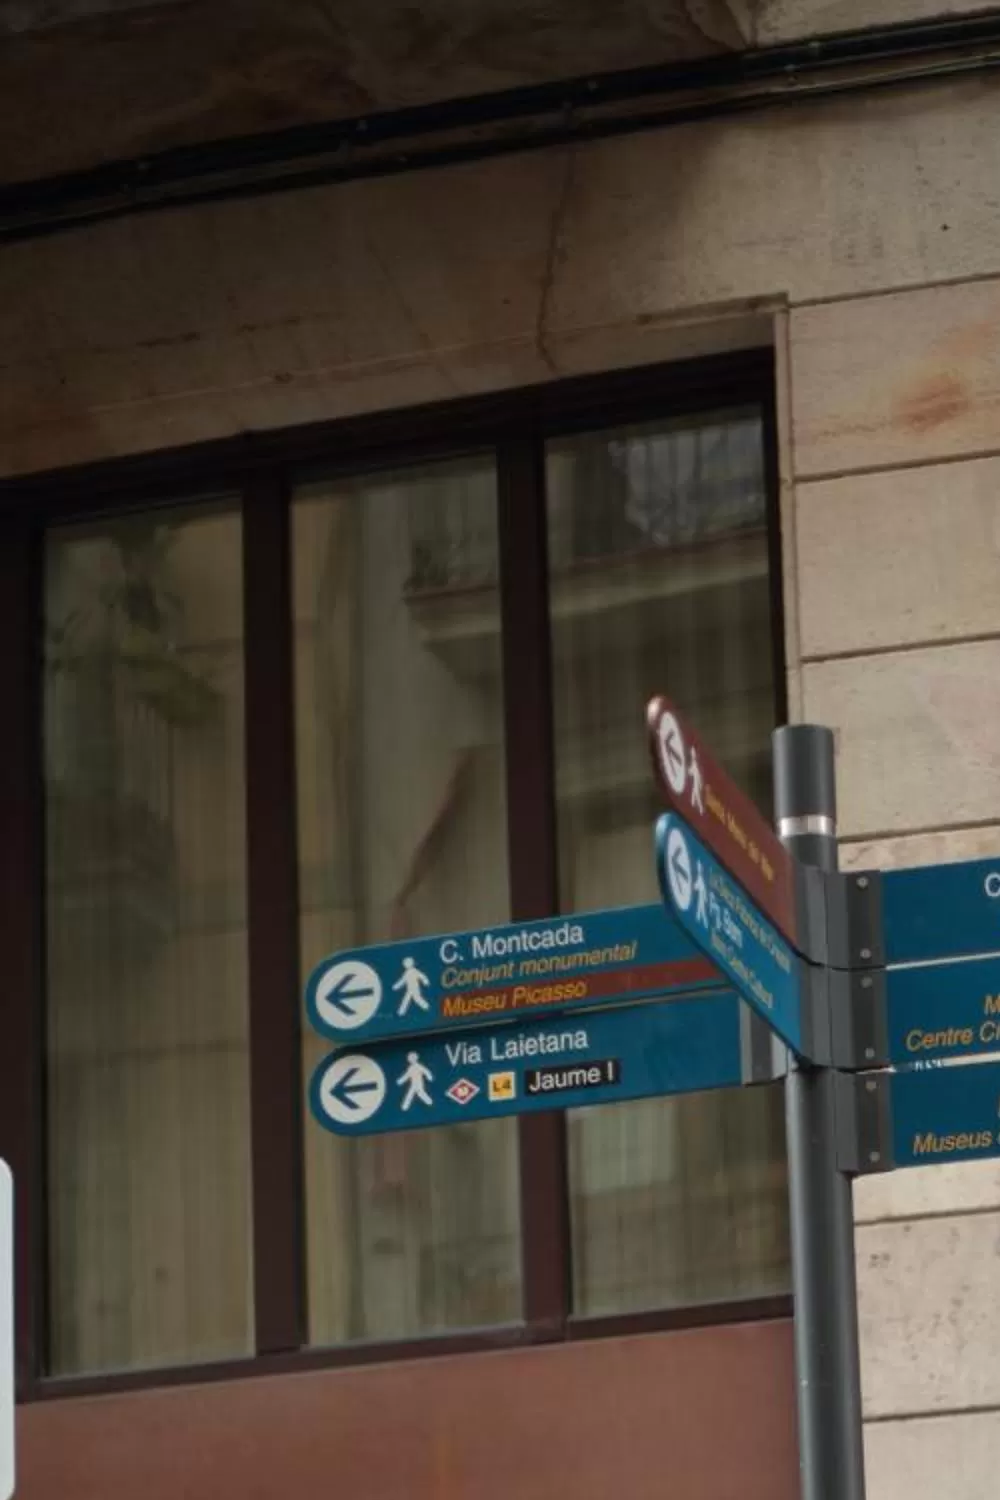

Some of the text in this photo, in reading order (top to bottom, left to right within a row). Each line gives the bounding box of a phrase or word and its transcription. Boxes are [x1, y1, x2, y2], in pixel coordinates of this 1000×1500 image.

[439, 923, 584, 964] C. Montcada
[441, 941, 639, 990] Conjunt monumental
[443, 981, 588, 1016] Museu Picasso
[445, 1028, 589, 1067] Via Laietana
[906, 1027, 972, 1051] Centre
[492, 1078, 512, 1092] L4
[529, 1065, 601, 1092] Jaume
[912, 1128, 992, 1154] Museus
